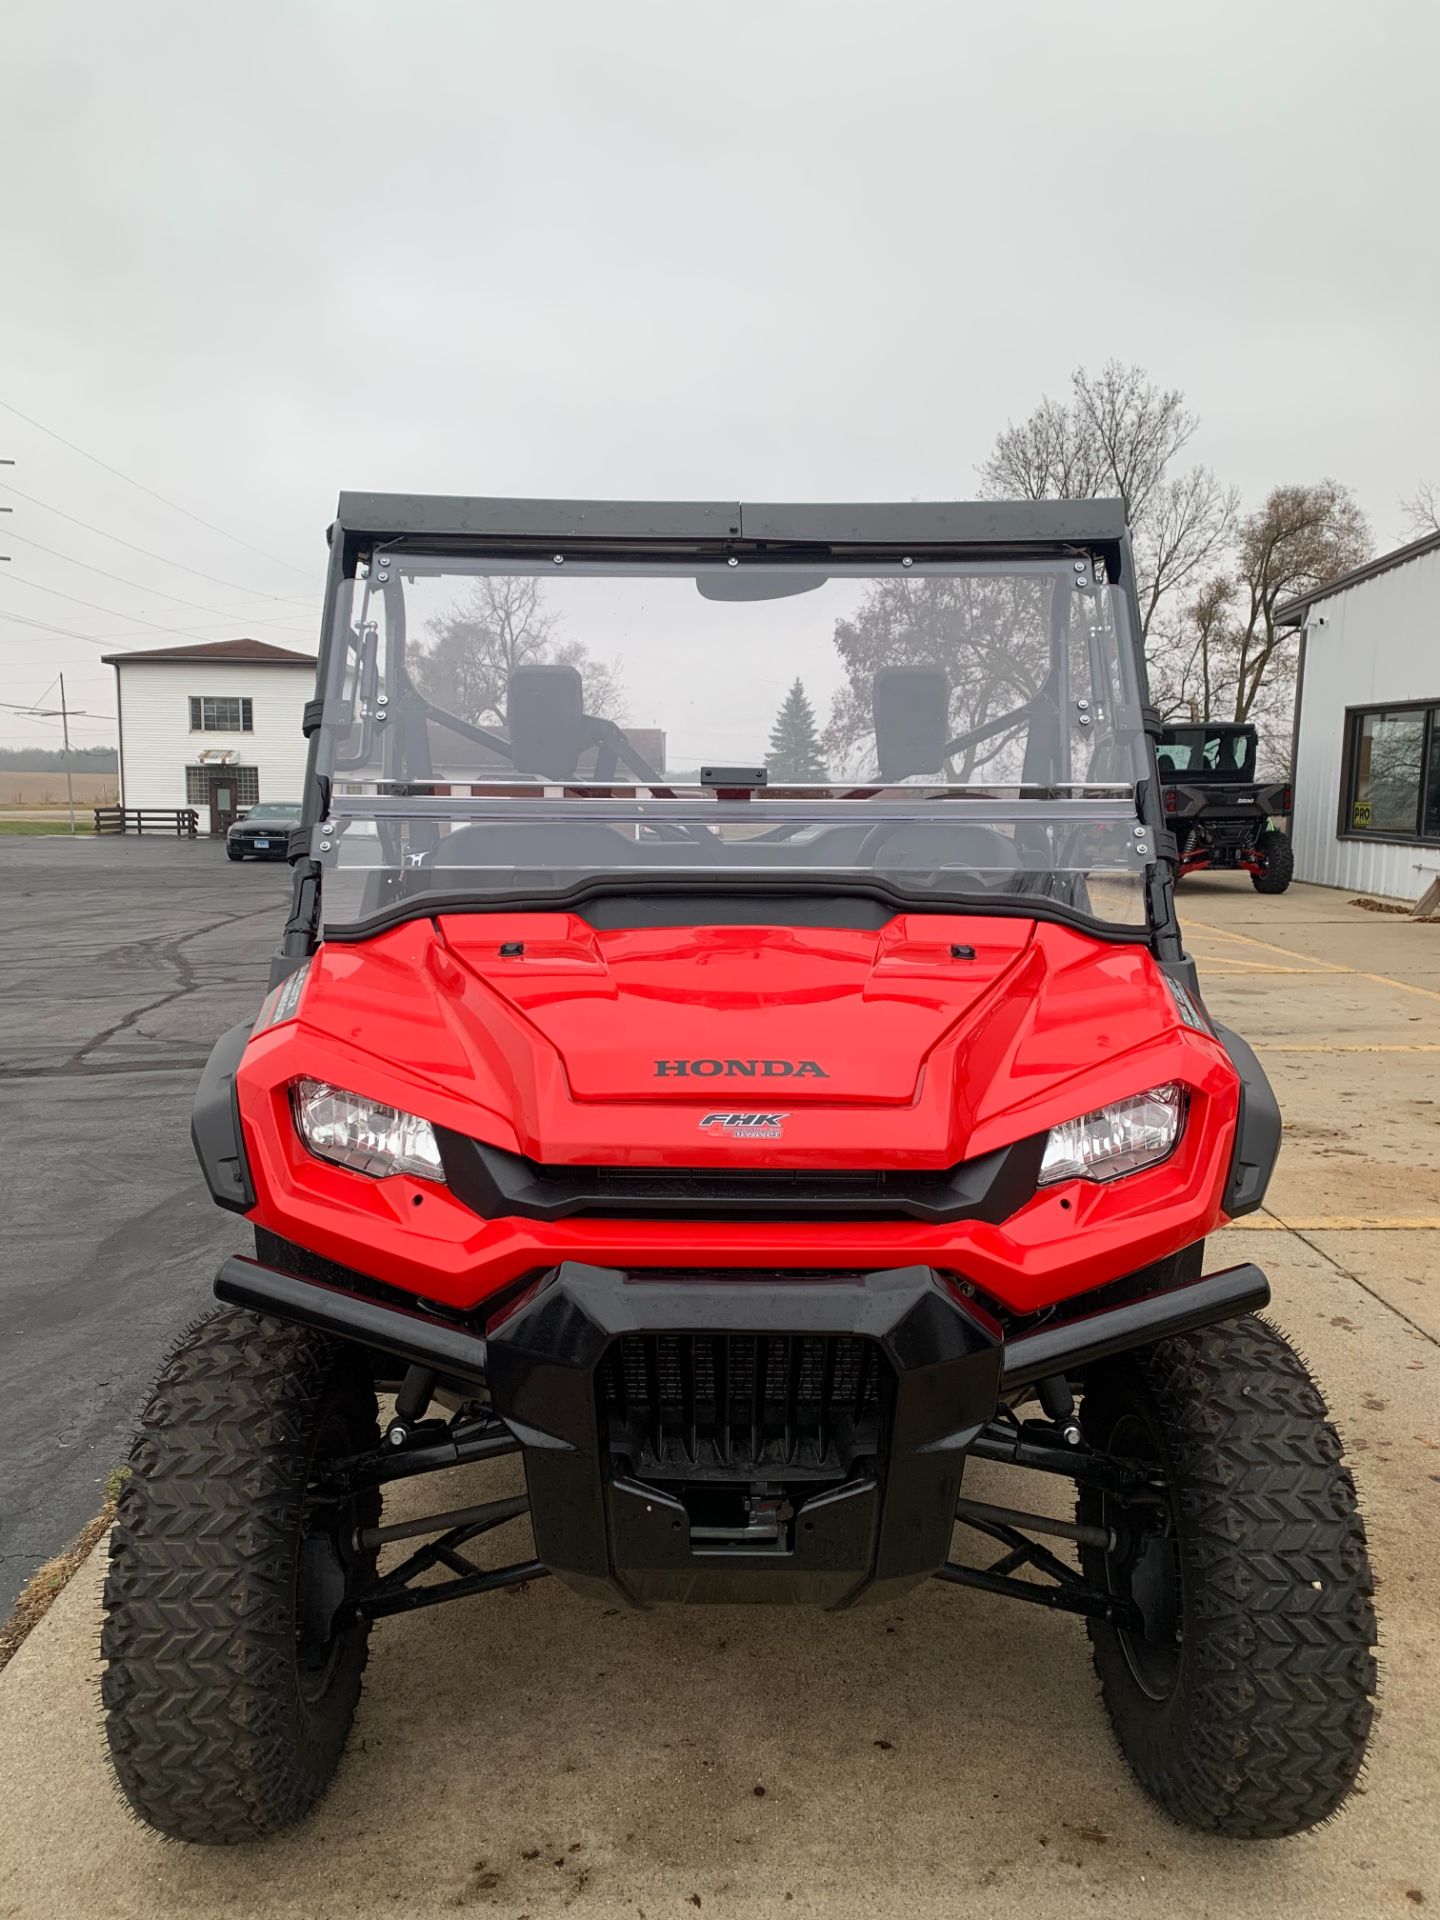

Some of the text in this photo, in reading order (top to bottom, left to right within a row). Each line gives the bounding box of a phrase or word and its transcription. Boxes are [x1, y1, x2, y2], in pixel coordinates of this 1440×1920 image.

[1355, 808, 1370, 819] PRO
[653, 1060, 830, 1077] HONDA
[699, 1112, 791, 1127] FHK
